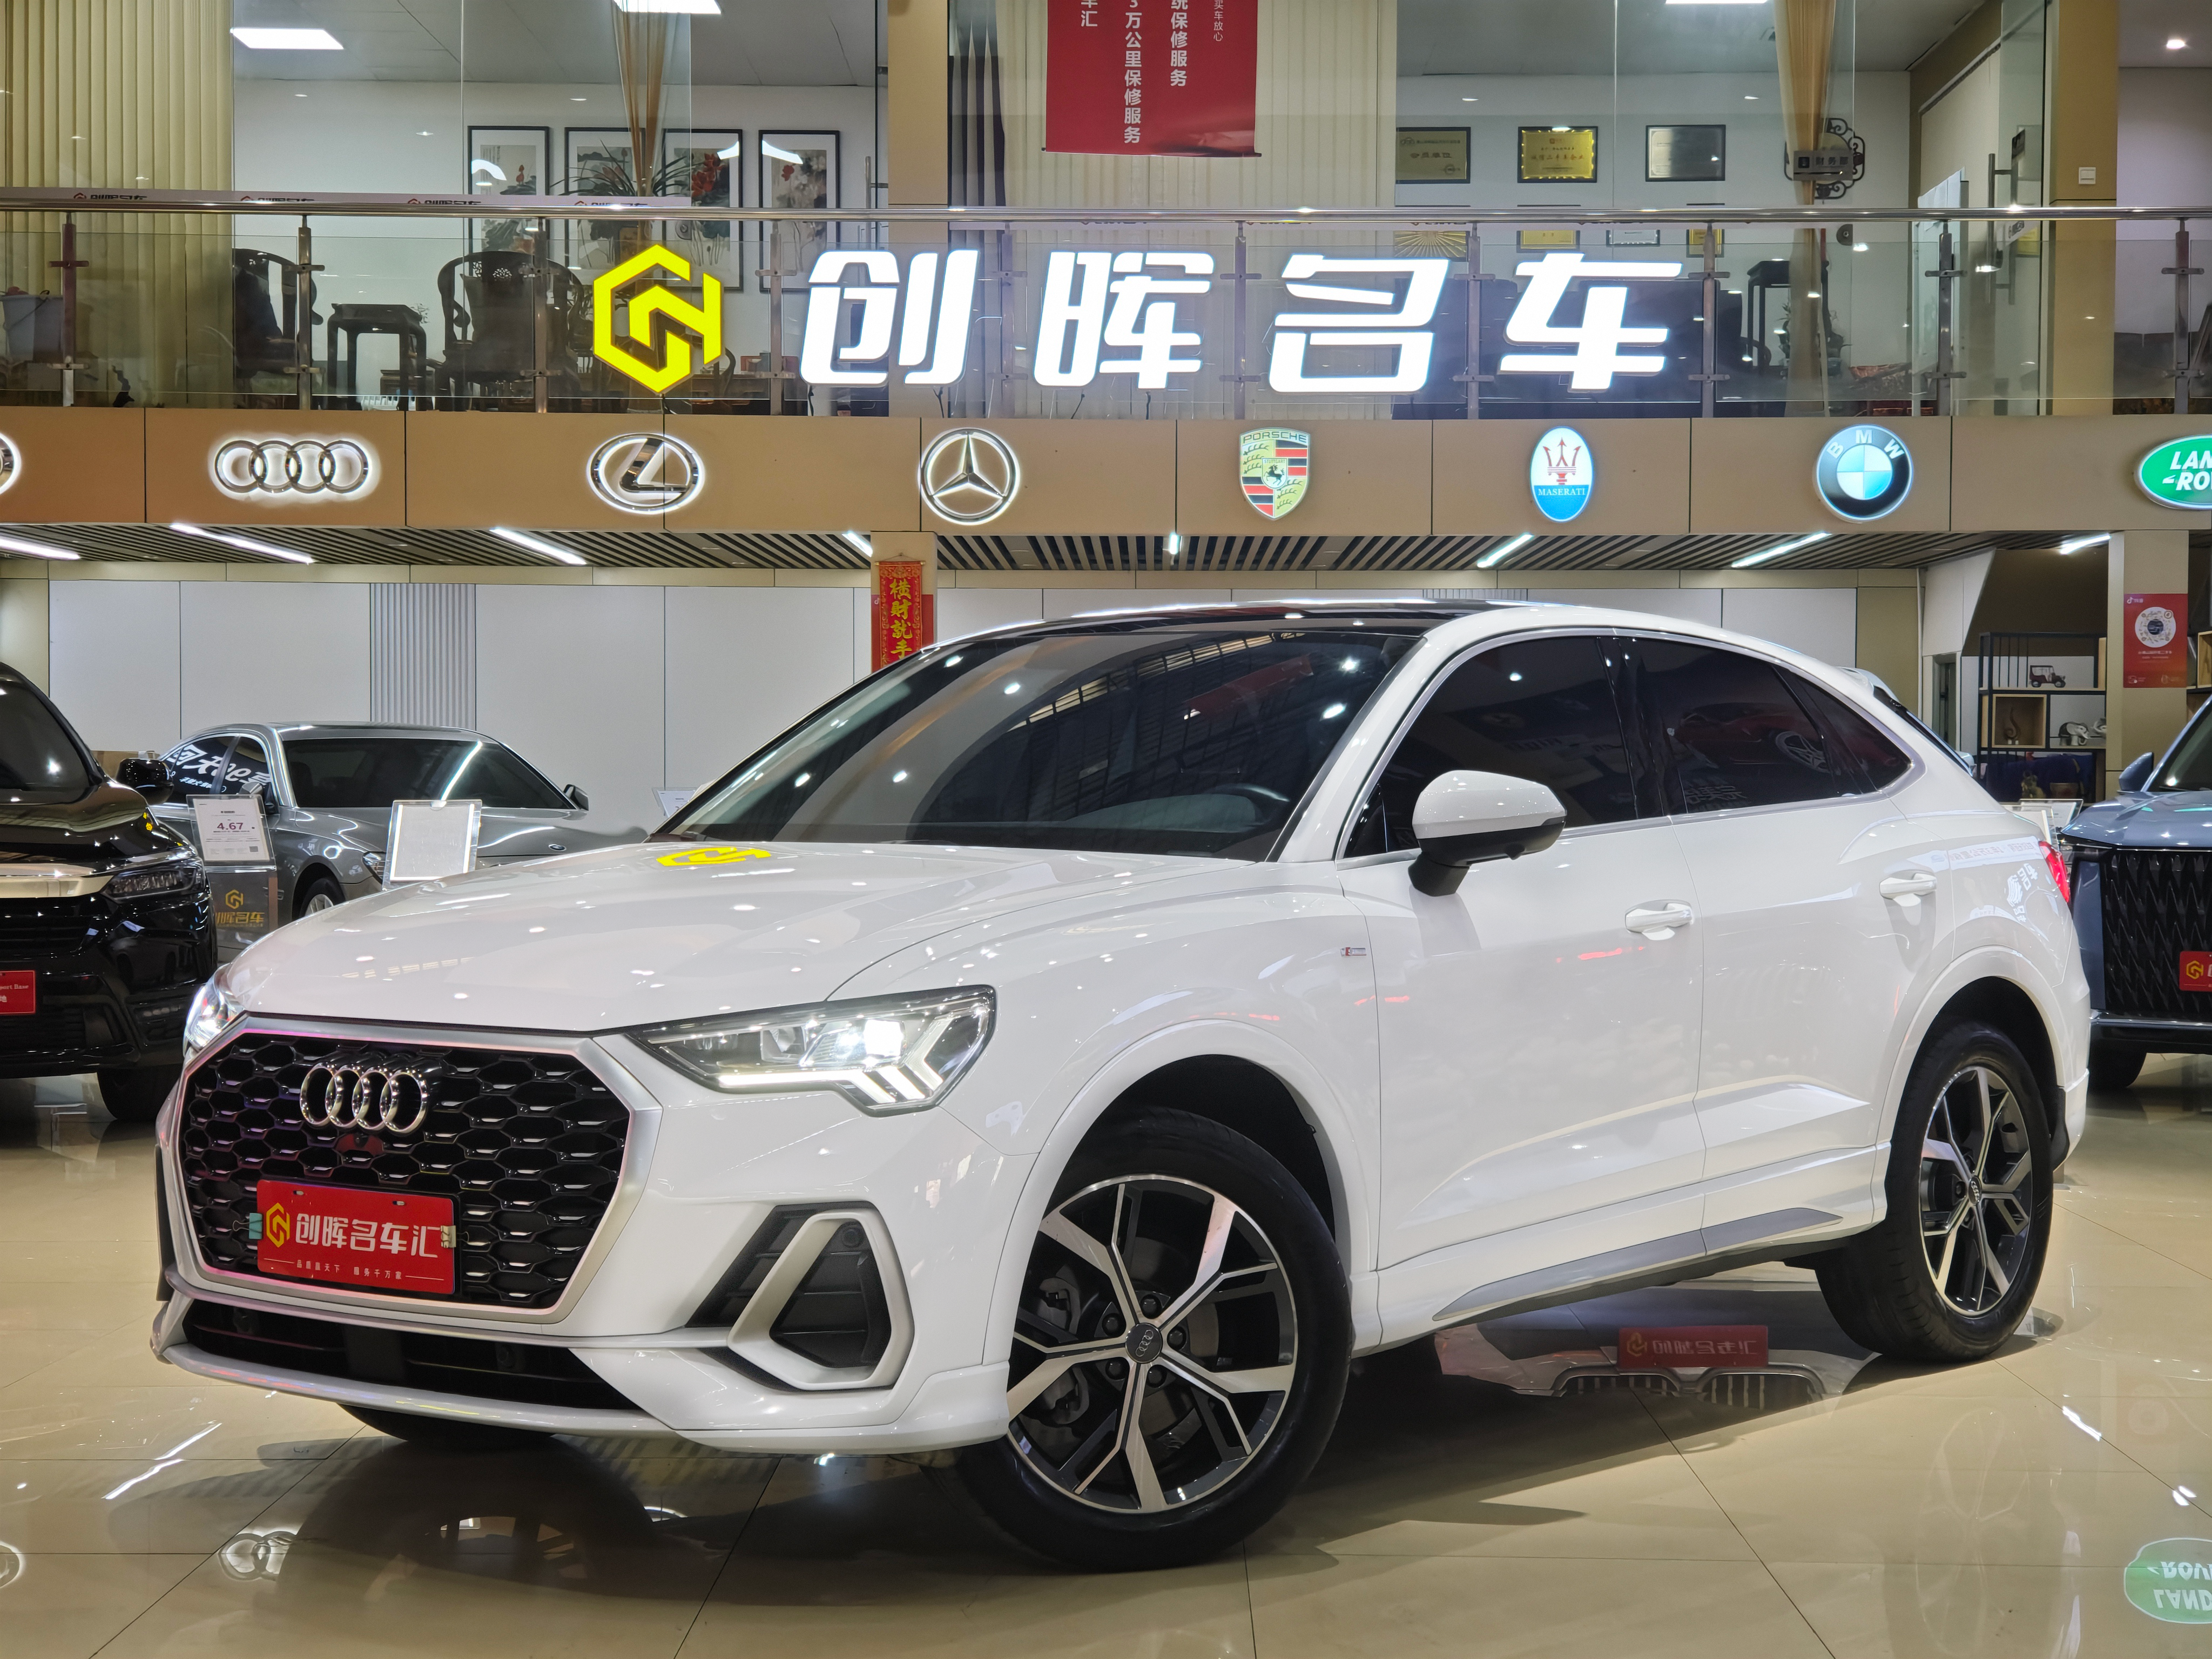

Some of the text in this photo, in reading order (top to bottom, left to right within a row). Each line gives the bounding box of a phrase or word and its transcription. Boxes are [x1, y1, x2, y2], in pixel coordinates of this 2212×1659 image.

[799, 248, 1684, 393] 创晖名车
[1243, 431, 1307, 444] PORSCHE
[1826, 429, 1905, 460] BMW
[2175, 471, 2212, 491] RO
[1538, 488, 1586, 496] MASERATI
[217, 822, 244, 831] 4.67
[295, 1213, 442, 1258] 创晖名车汇
